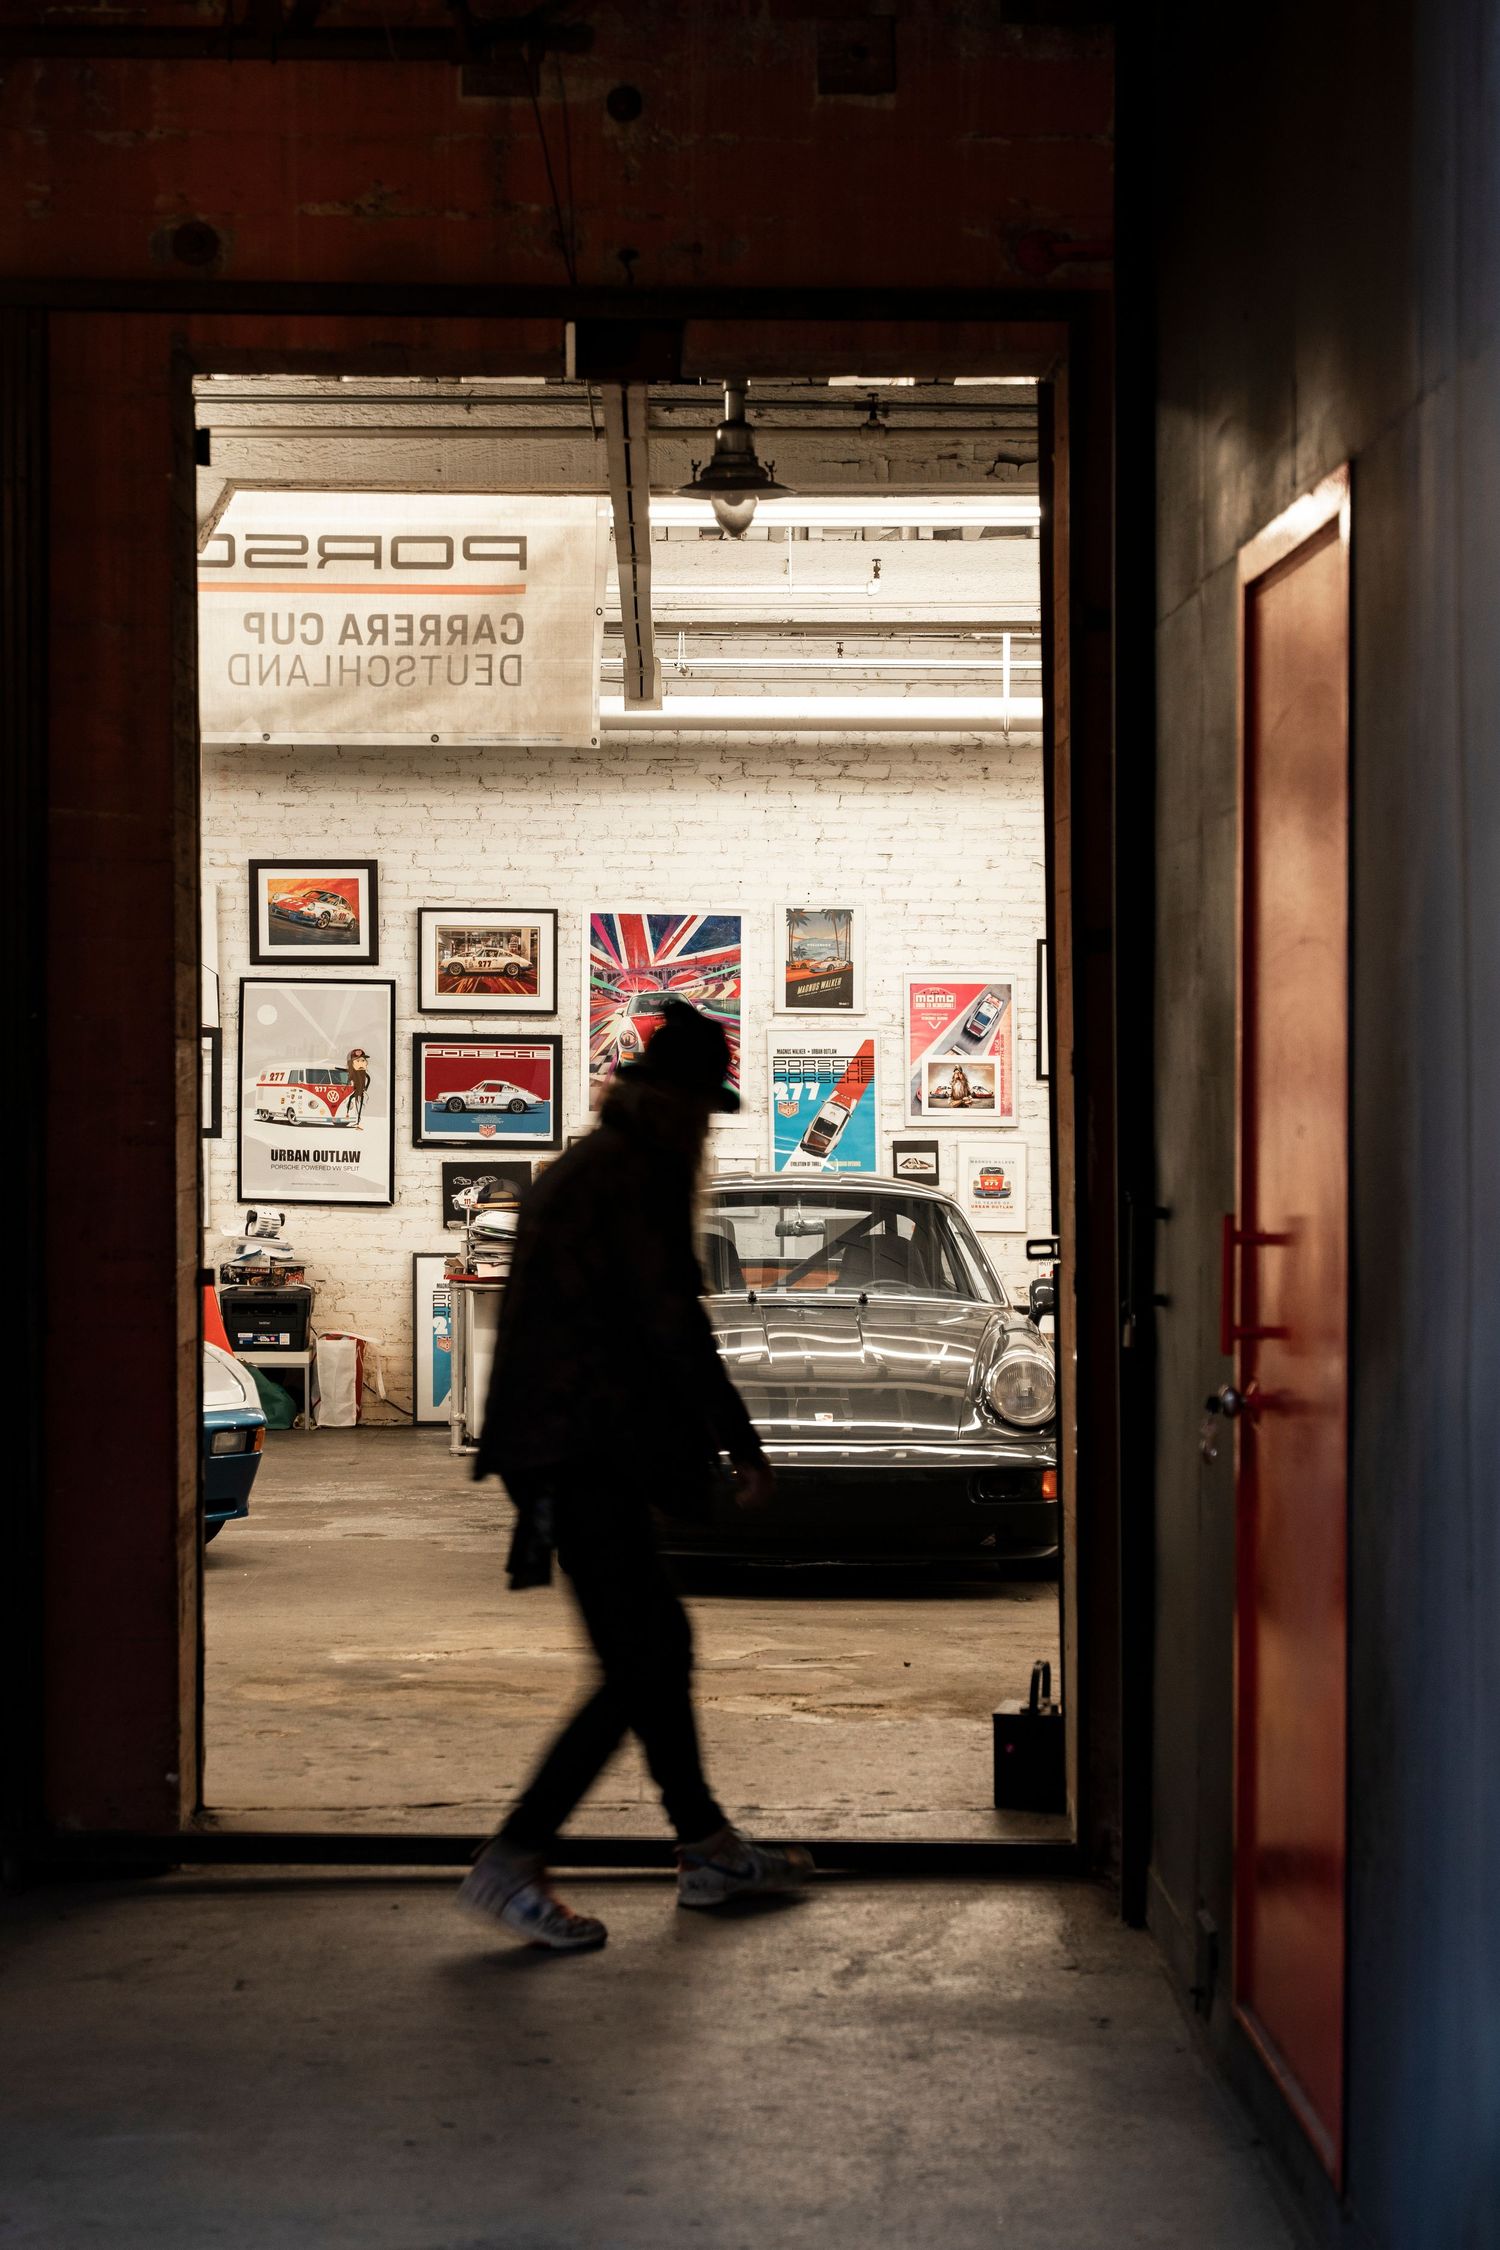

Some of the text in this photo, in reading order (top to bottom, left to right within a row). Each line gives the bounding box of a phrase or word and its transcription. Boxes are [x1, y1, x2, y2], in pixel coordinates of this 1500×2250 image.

[478, 960, 492, 968] 277
[797, 983, 820, 994] MAGNUS
[820, 977, 842, 989] WALKER
[773, 1059, 874, 1067] PORSCHE
[269, 1072, 285, 1082] 277
[774, 1082, 820, 1100] 277
[479, 1096, 495, 1104] 277
[270, 1149, 361, 1163] URBAN OUTLAW
